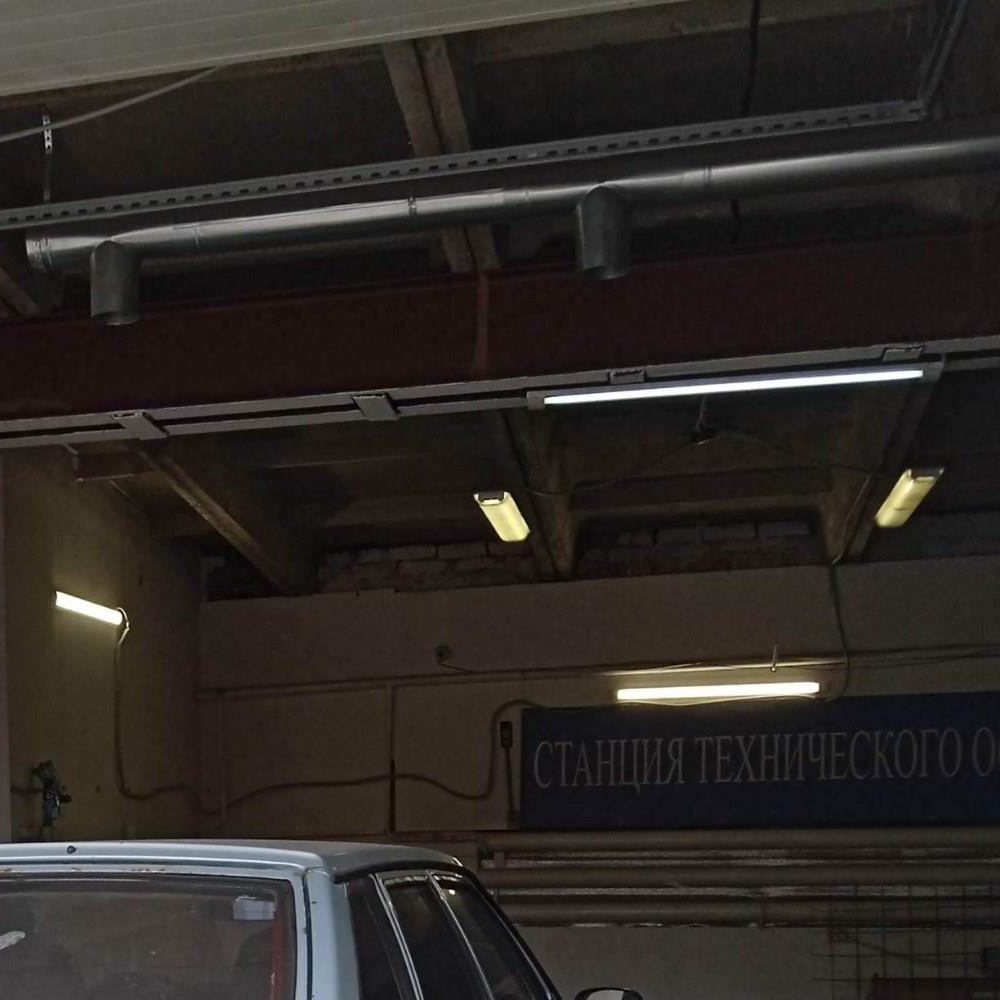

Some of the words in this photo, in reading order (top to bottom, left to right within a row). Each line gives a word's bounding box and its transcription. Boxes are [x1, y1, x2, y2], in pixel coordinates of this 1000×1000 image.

[533, 738, 685, 797] СТАНЦИЯ
[693, 727, 963, 785] ТЕХНИЧЕСКОГО
[972, 727, 1000, 777] О
